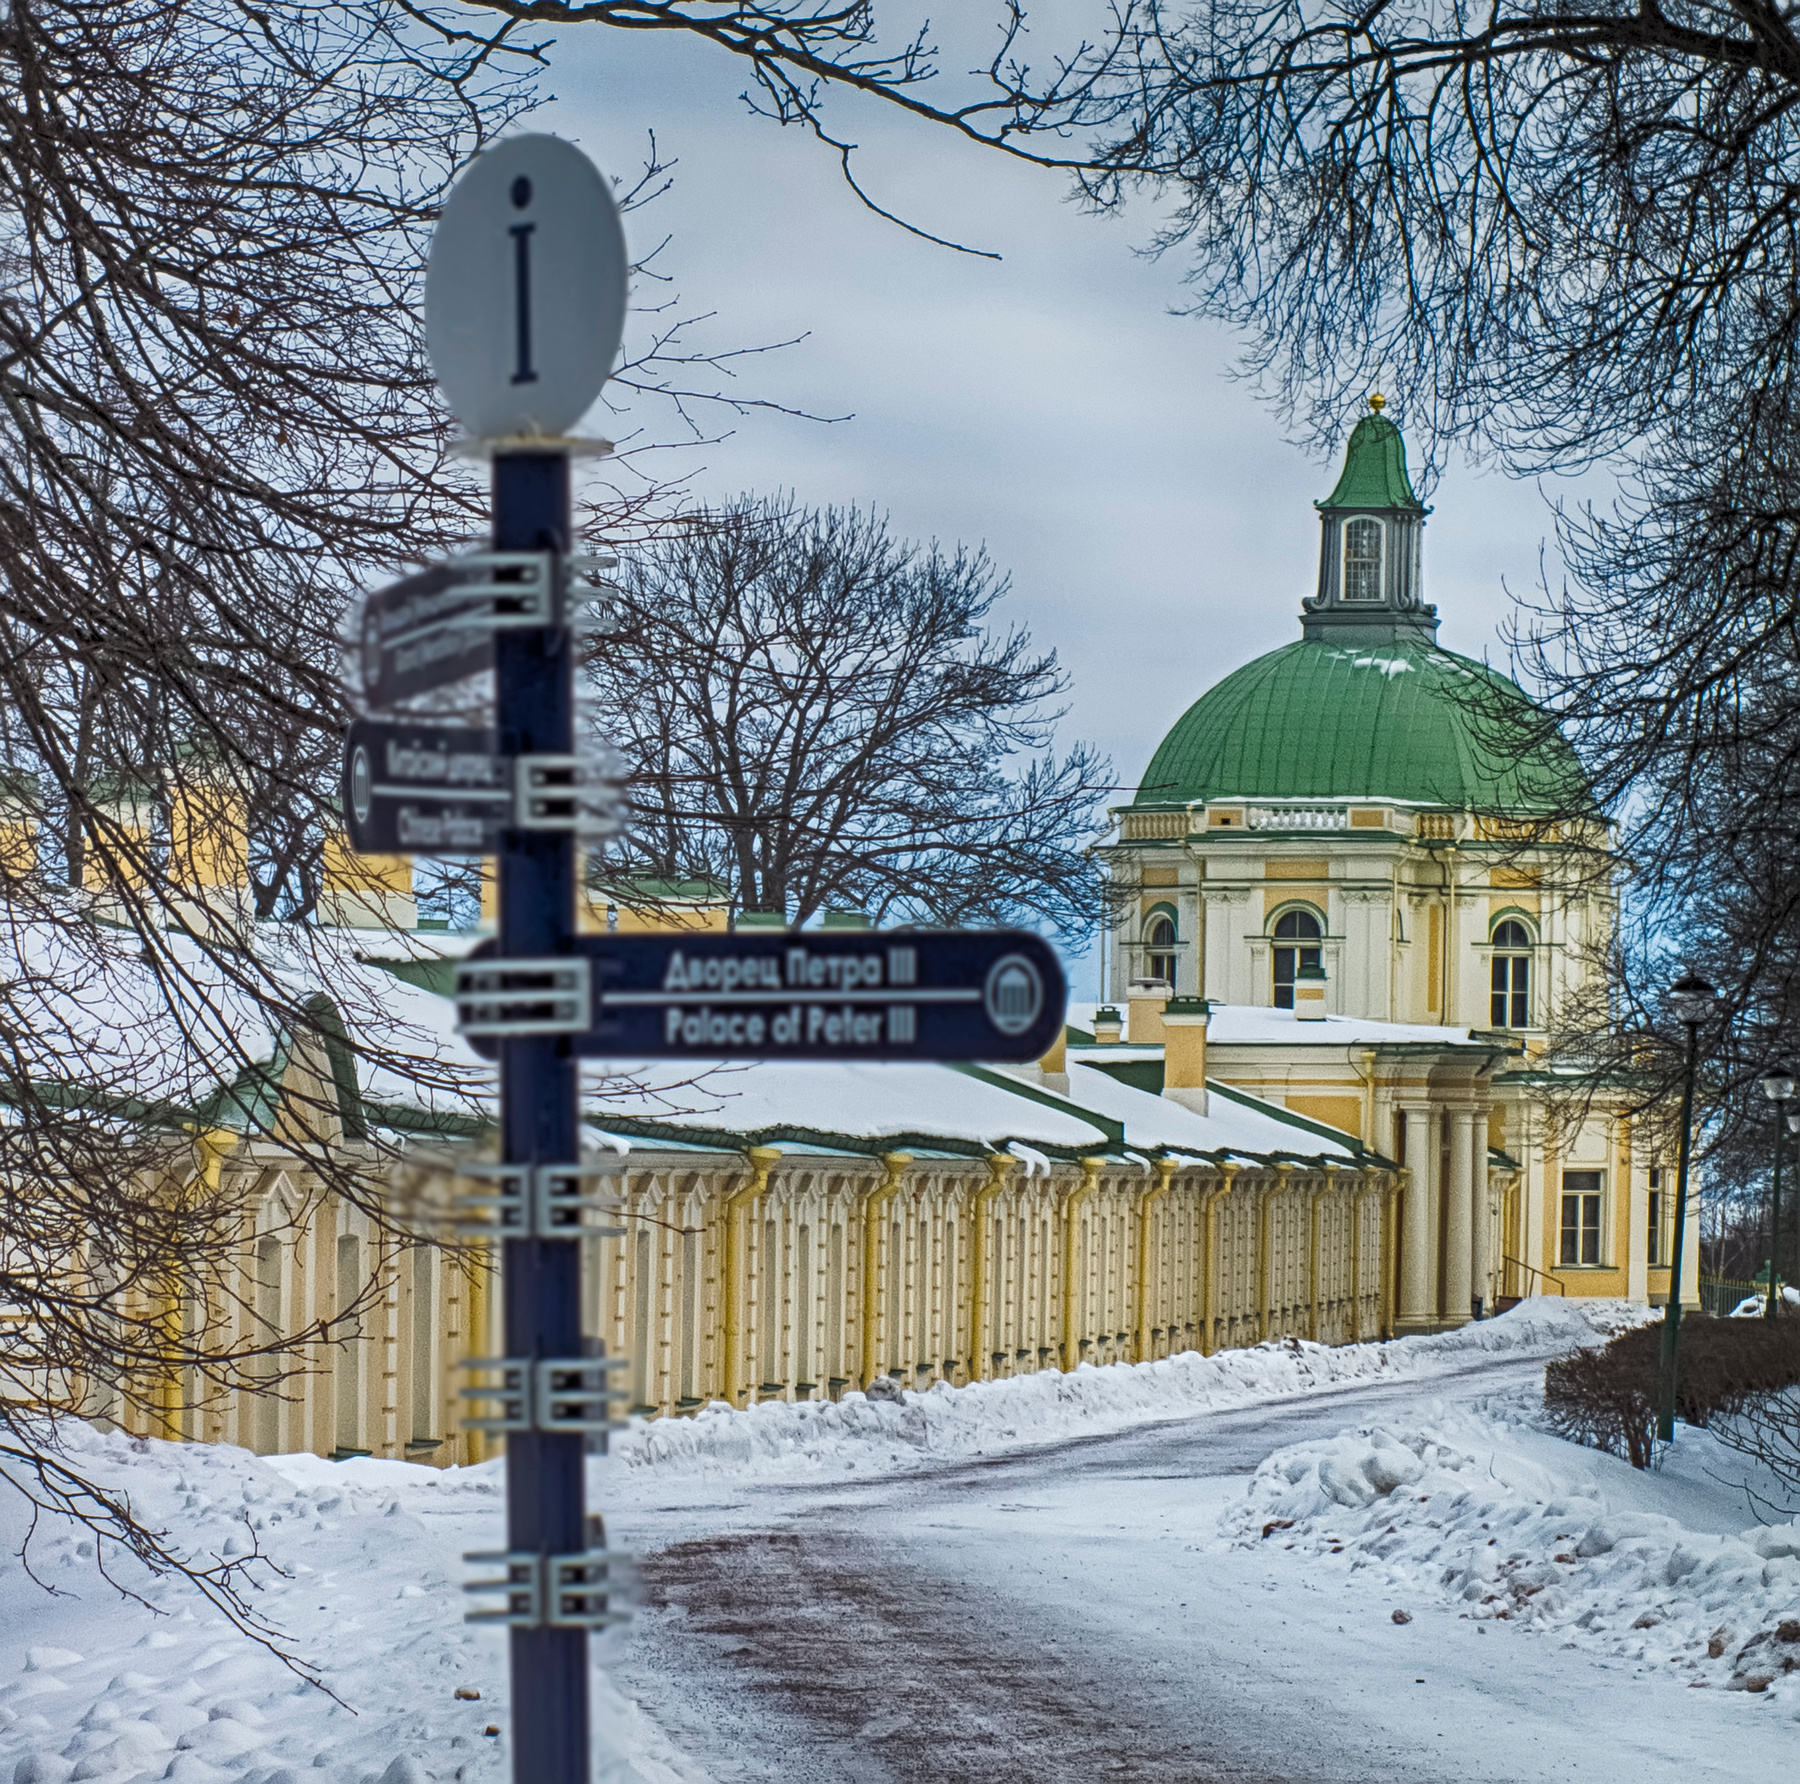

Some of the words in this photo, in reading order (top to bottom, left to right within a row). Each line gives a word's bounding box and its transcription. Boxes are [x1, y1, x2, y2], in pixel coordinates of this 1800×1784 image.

[508, 174, 538, 386] i
[665, 951, 781, 991] Дворец
[787, 948, 882, 990] Петра
[888, 947, 916, 985] III
[666, 1007, 765, 1044] Palace
[771, 1007, 800, 1044] of
[807, 1007, 882, 1044] Peter
[888, 1007, 916, 1044] III
